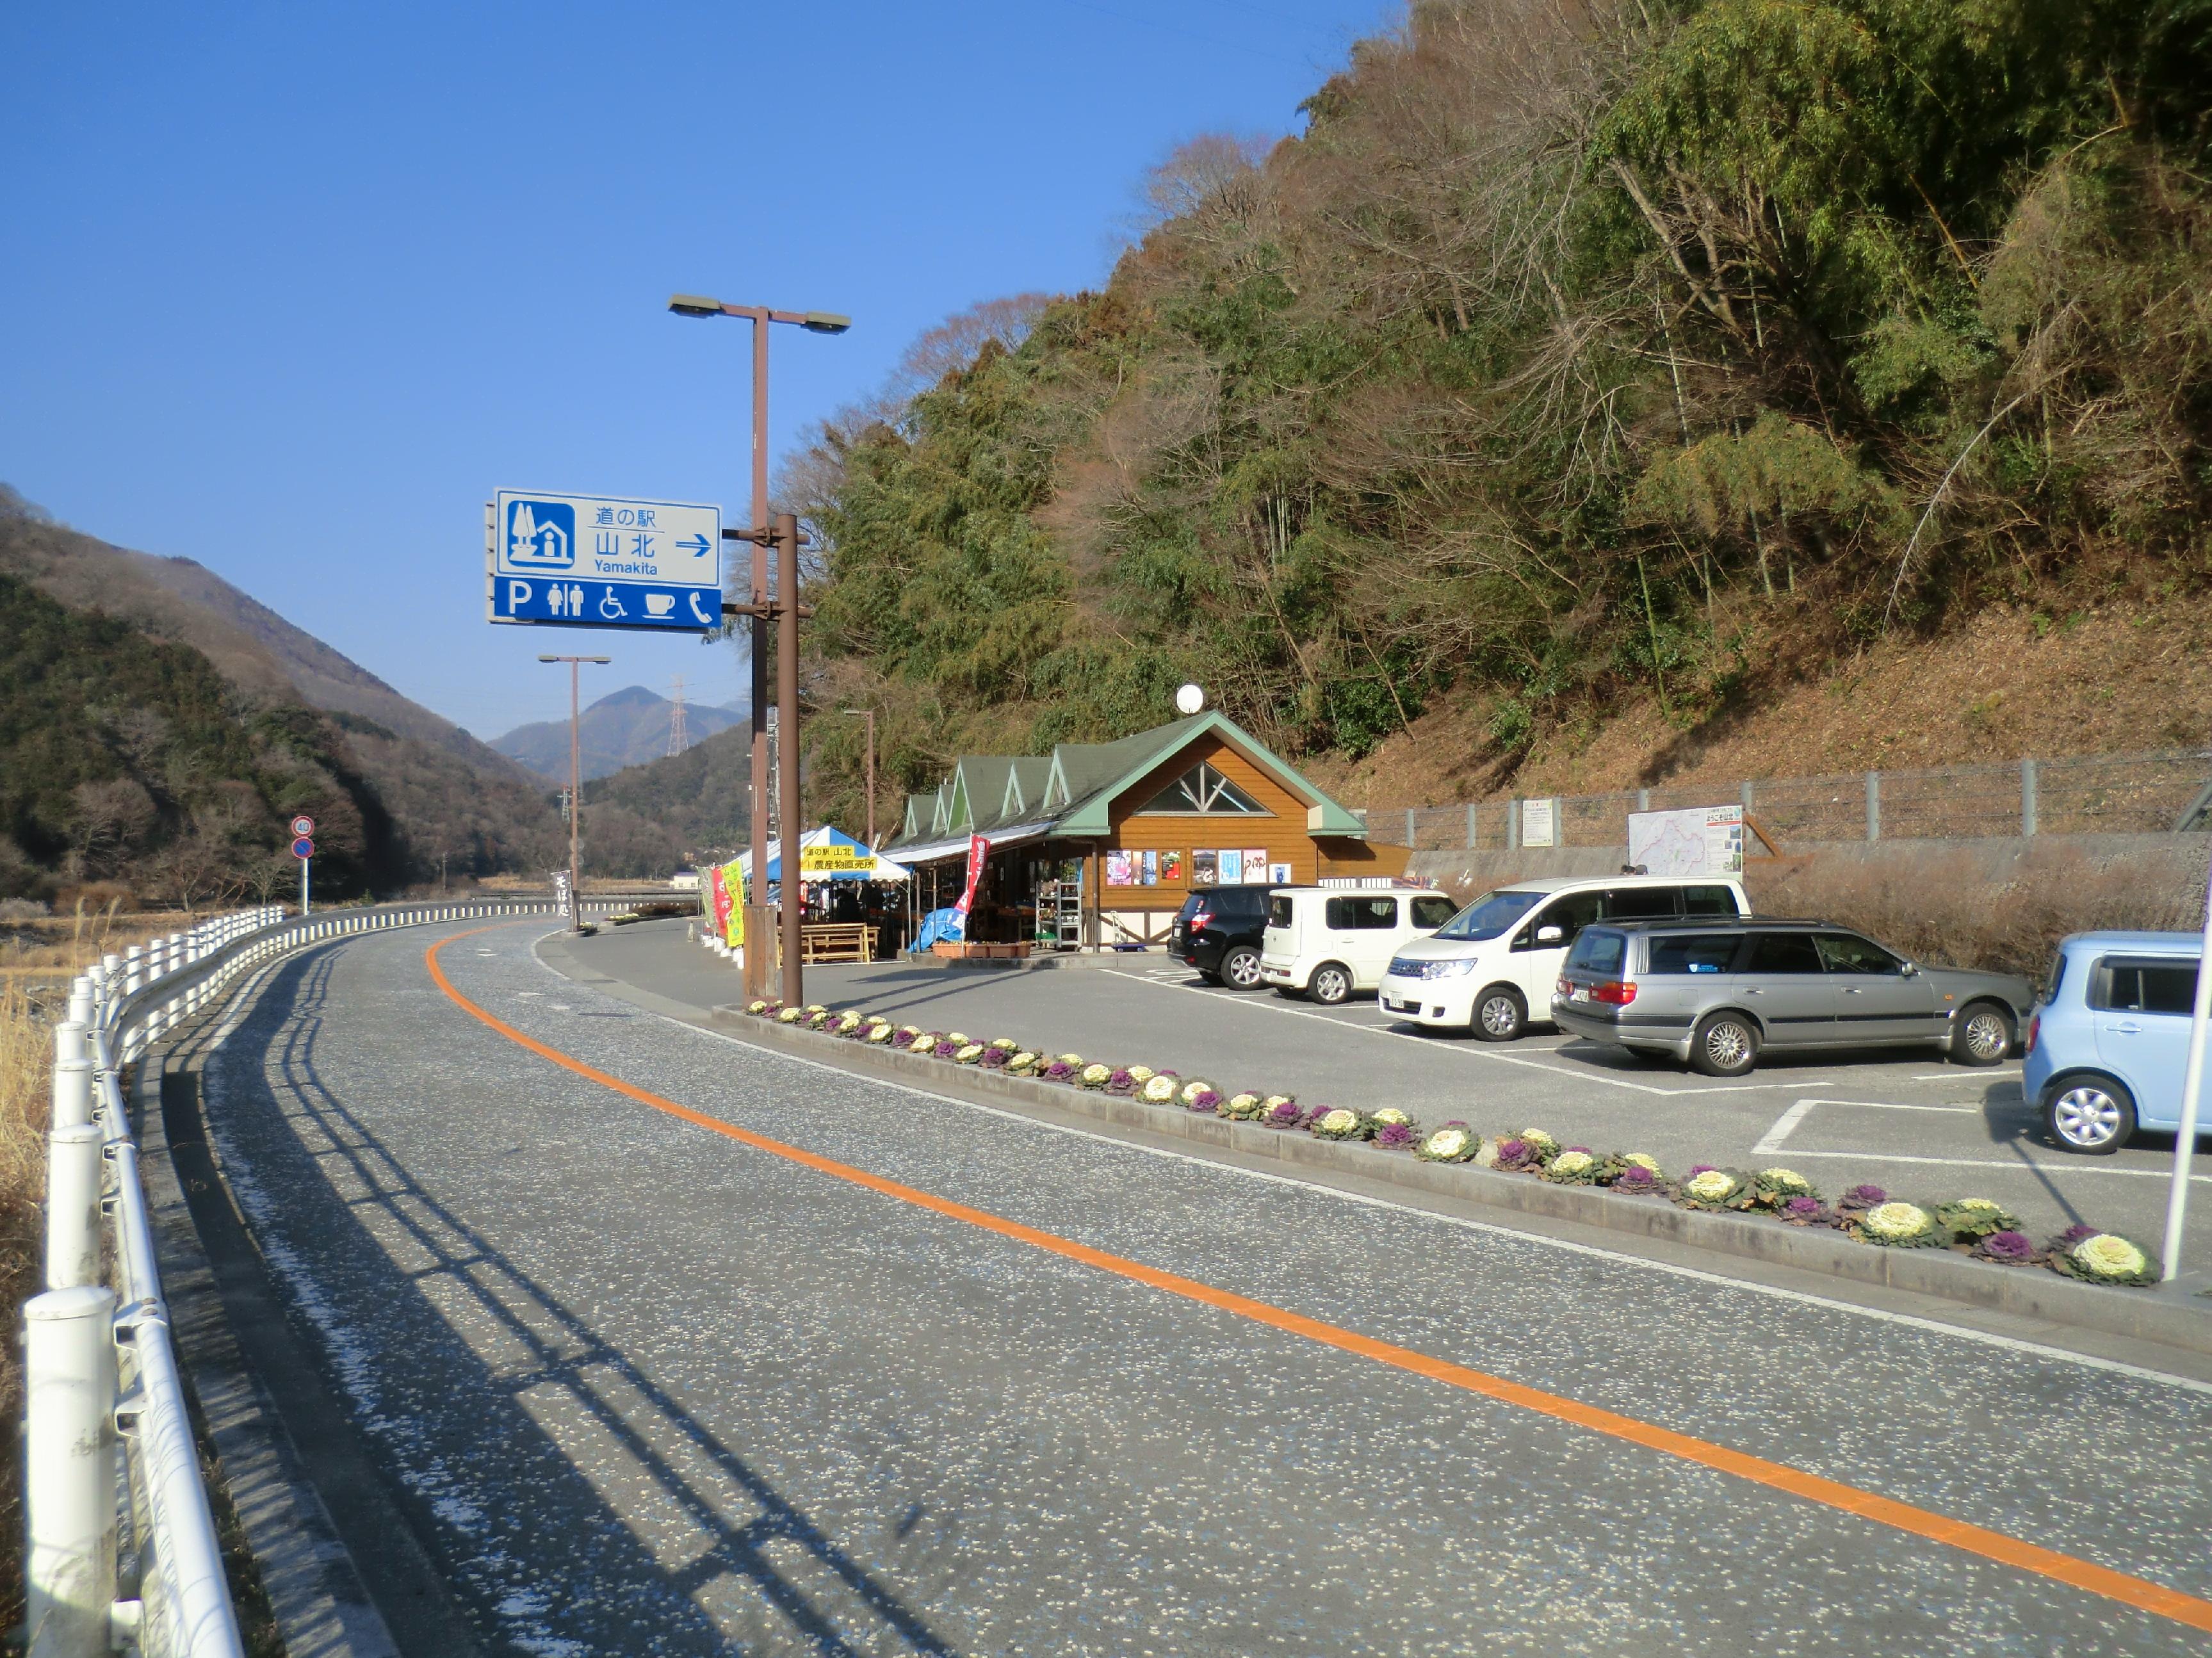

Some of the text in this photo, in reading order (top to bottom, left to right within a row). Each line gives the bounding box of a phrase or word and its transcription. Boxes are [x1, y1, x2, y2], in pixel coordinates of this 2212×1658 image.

[596, 507, 655, 528] 道の駅
[596, 533, 655, 558] 山北
[595, 560, 658, 575] Yamakita
[509, 580, 532, 614] P
[298, 822, 309, 831] 40
[806, 847, 851, 856] 道の駅 山北
[814, 859, 875, 870] 農産物直売所
